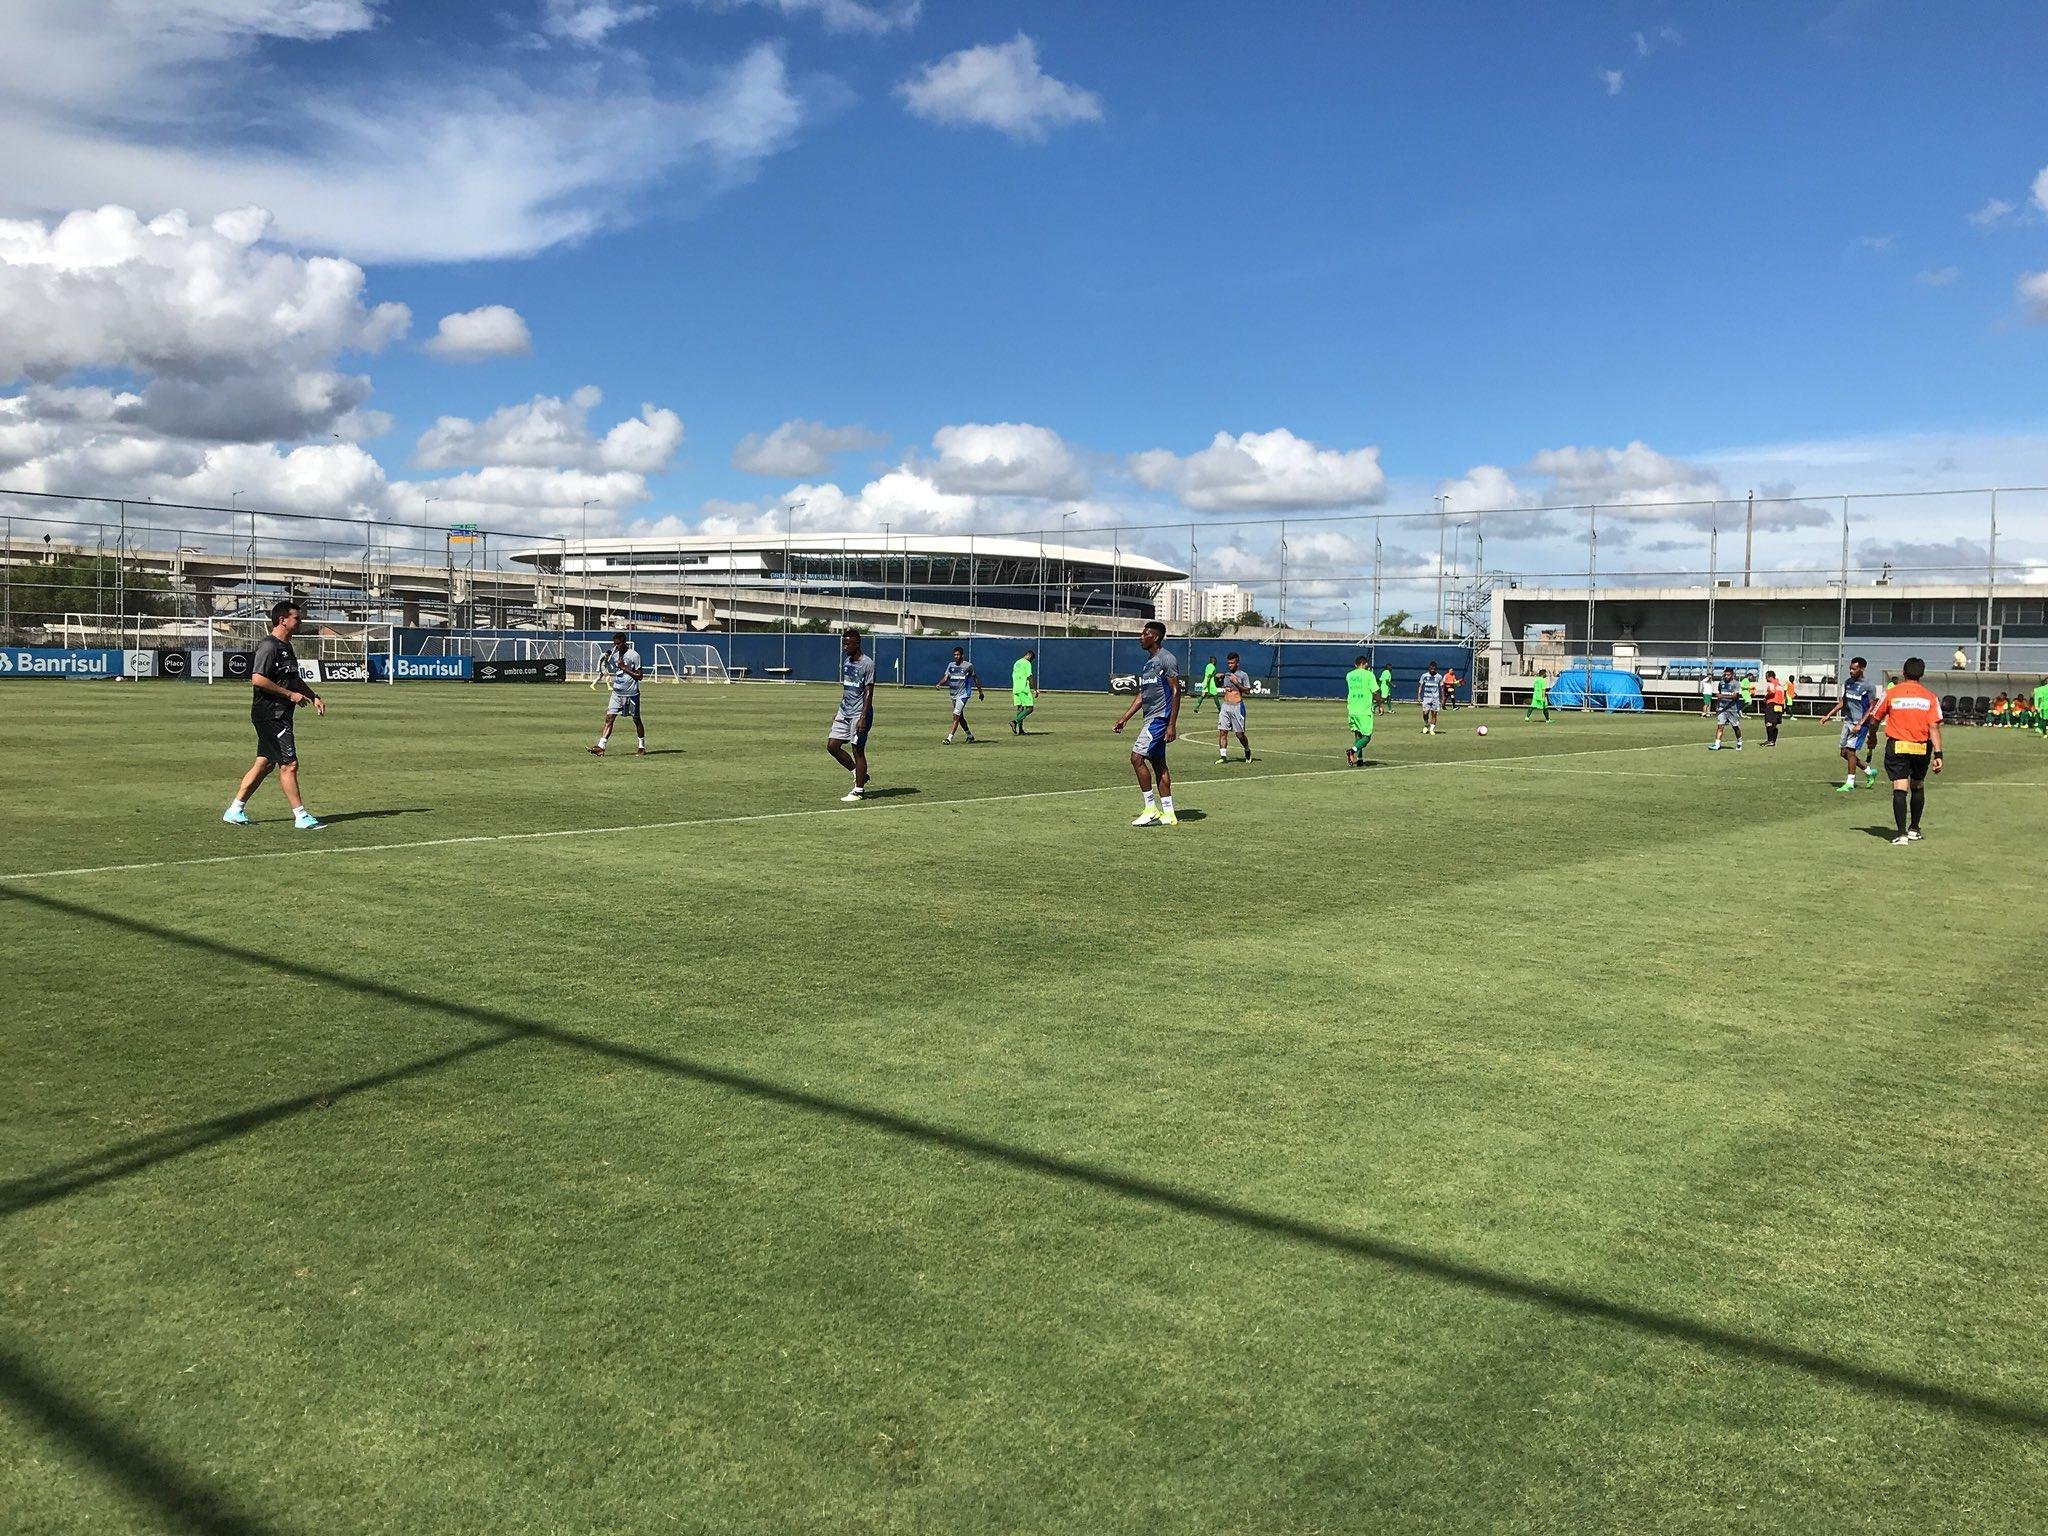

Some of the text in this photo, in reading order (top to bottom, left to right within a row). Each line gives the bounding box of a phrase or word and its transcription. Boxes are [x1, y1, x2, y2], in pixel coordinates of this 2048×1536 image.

[18, 653, 107, 672] Banrisul
[398, 660, 462, 676] Banrisul
[325, 666, 370, 679] LaSalle
